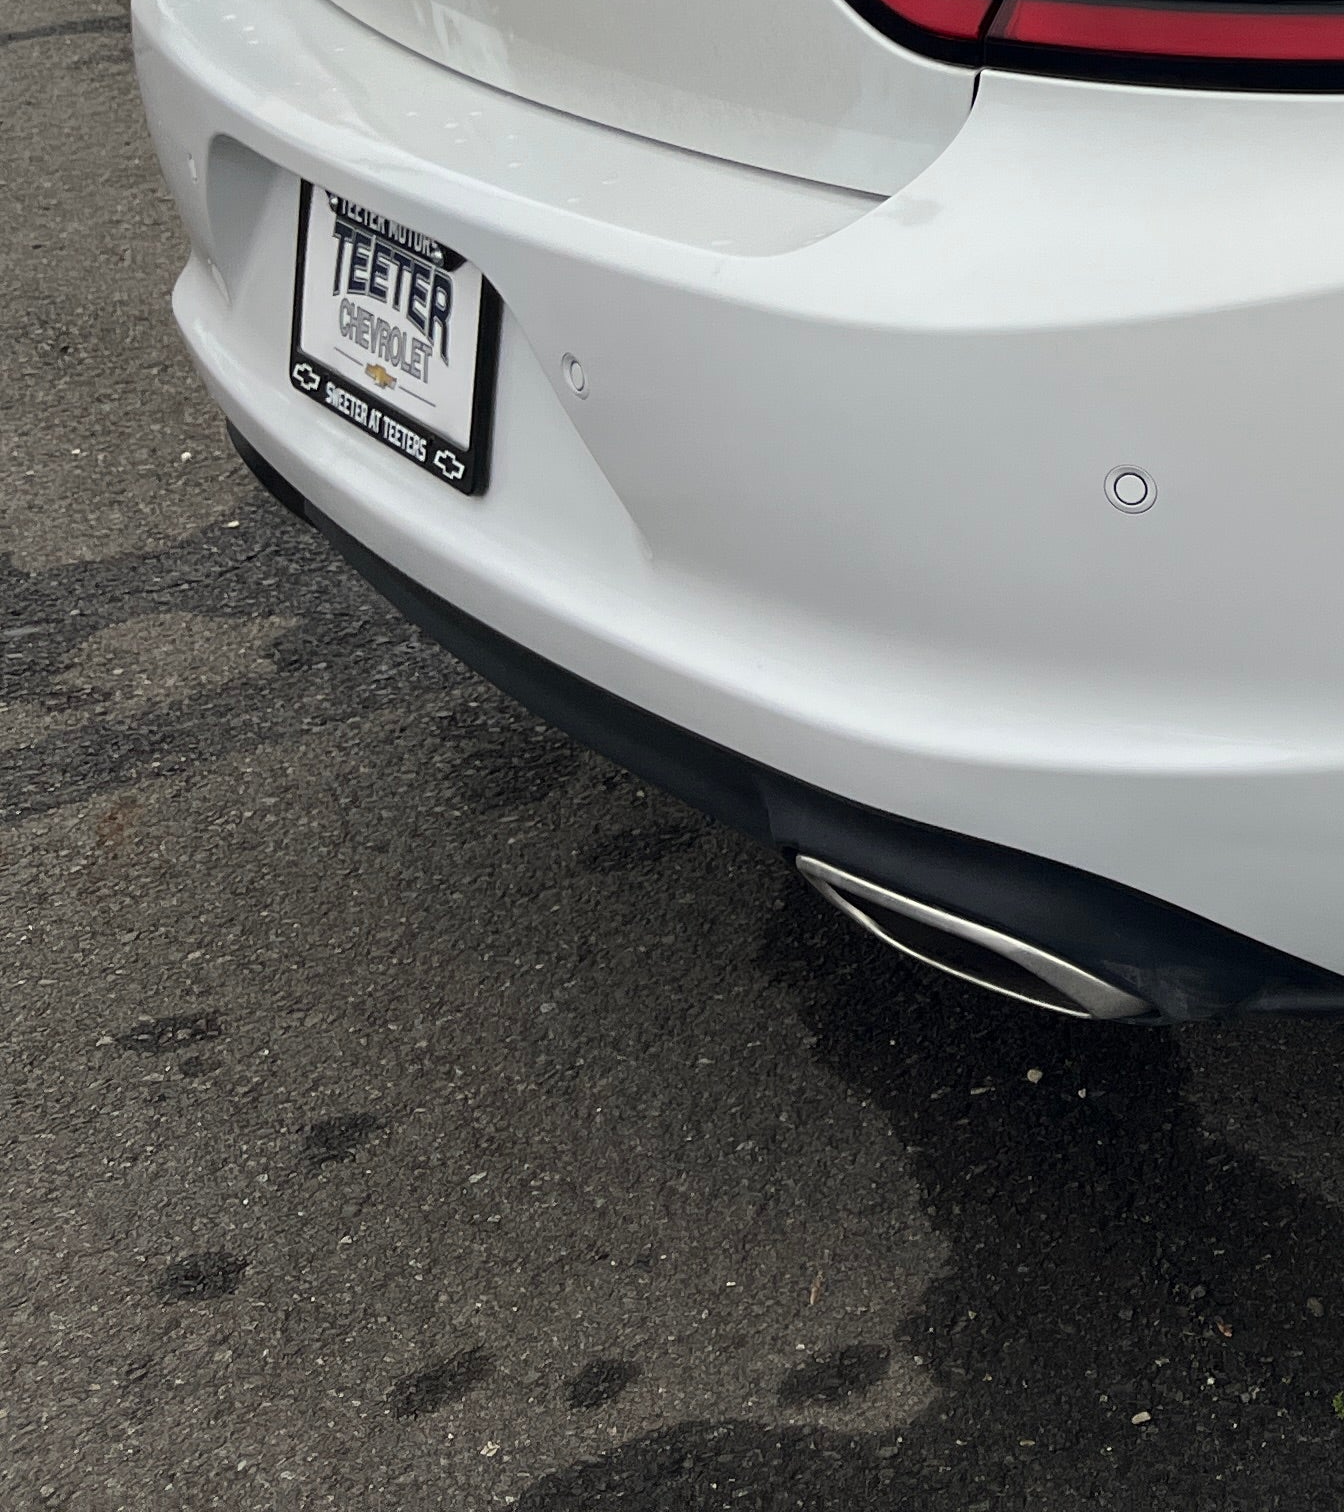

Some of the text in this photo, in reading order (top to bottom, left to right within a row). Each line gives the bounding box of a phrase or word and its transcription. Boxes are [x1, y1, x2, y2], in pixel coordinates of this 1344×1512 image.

[332, 218, 454, 366] TEETER
[339, 297, 433, 384] CHEVROLET
[368, 408, 383, 434] AT
[383, 415, 428, 462] TEETERS
